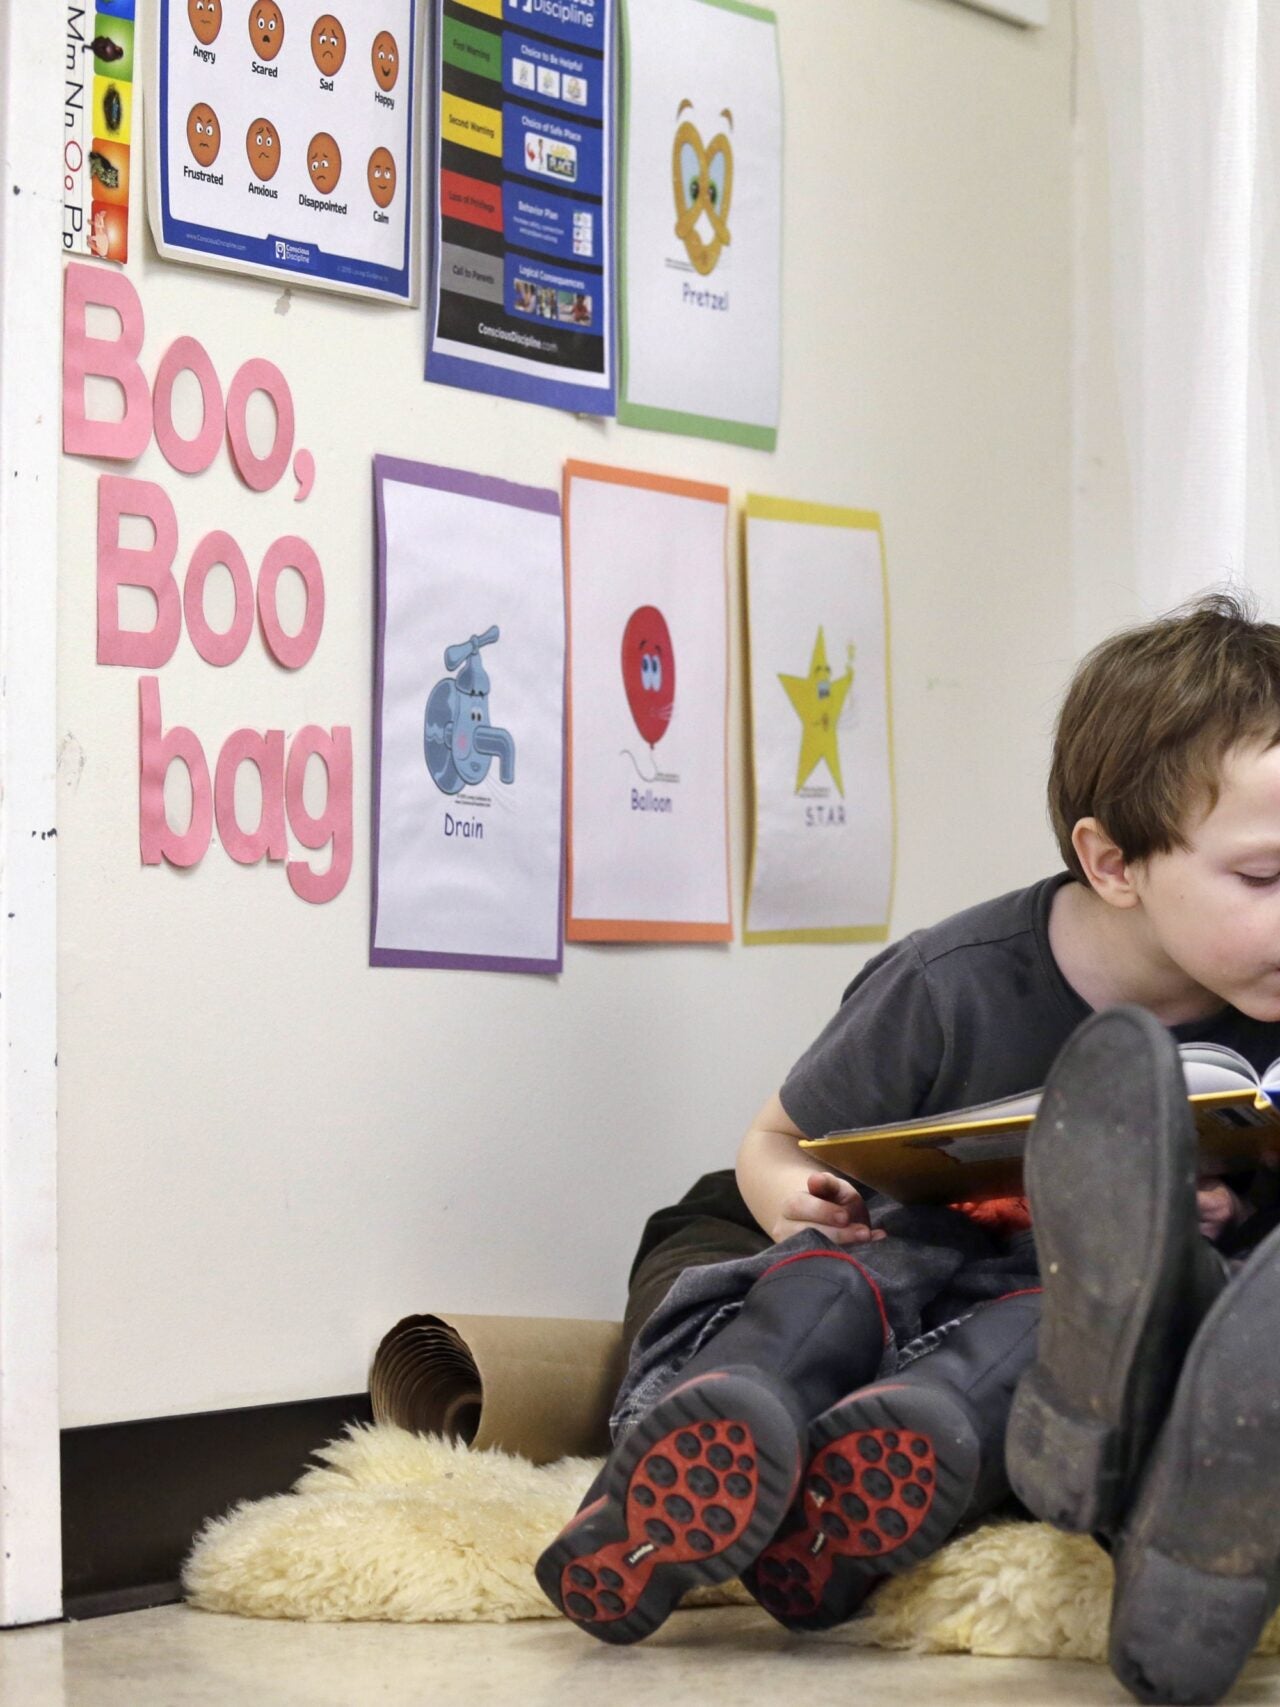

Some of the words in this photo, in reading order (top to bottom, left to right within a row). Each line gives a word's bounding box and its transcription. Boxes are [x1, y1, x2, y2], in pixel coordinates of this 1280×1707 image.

[534, 0, 595, 28] Discipline
[192, 45, 216, 64] Angry
[520, 44, 542, 60] Choice
[549, 53, 559, 65] Be
[559, 56, 583, 72] Helpful
[251, 61, 278, 78] Scared
[319, 78, 334, 91] Sad
[374, 91, 395, 110] Happy
[449, 114, 469, 130] Second
[470, 122, 495, 139] Warning
[521, 115, 543, 131] Choice
[563, 128, 582, 142] Place
[183, 165, 224, 186] Frustrated
[248, 182, 278, 199] Anxious
[298, 194, 347, 215] Disappointed
[518, 200, 543, 216] Behavior
[544, 206, 559, 220] Plan
[373, 210, 390, 224] Calm
[286, 243, 310, 256] Conscious
[286, 251, 310, 264] Discipline
[453, 264, 464, 276] Call
[472, 270, 494, 284] Parents
[519, 265, 539, 280] Logical
[539, 270, 585, 290] Consequences
[682, 281, 729, 311] Pretzel
[478, 321, 558, 352] ConsciousDiscipline.com
[63, 261, 316, 502] Boo,
[97, 474, 325, 672] Boo
[139, 676, 353, 904] bag
[631, 788, 672, 813] Balloon
[445, 812, 483, 839] Drain
